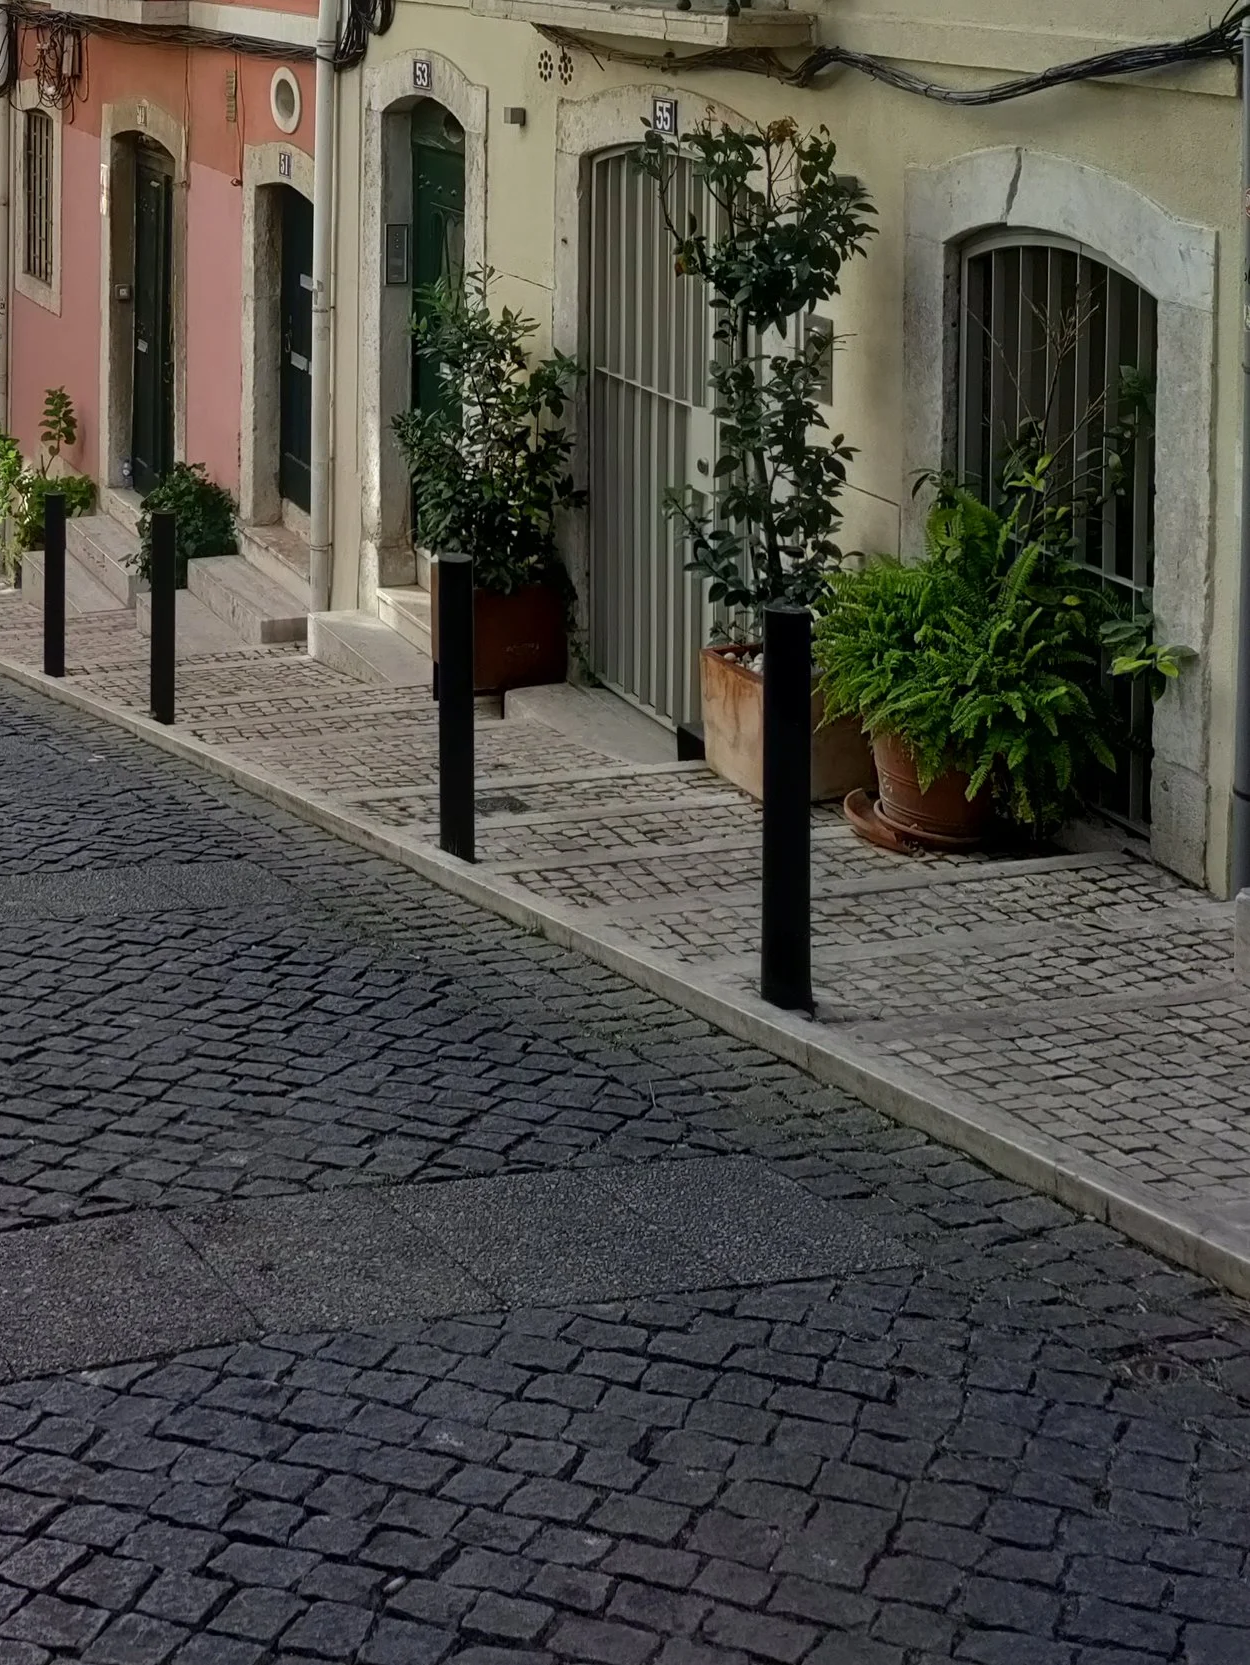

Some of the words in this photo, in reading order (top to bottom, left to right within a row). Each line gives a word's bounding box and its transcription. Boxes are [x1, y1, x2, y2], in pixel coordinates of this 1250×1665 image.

[416, 62, 428, 86] 53
[655, 101, 671, 130] 55
[280, 154, 289, 175] 51
